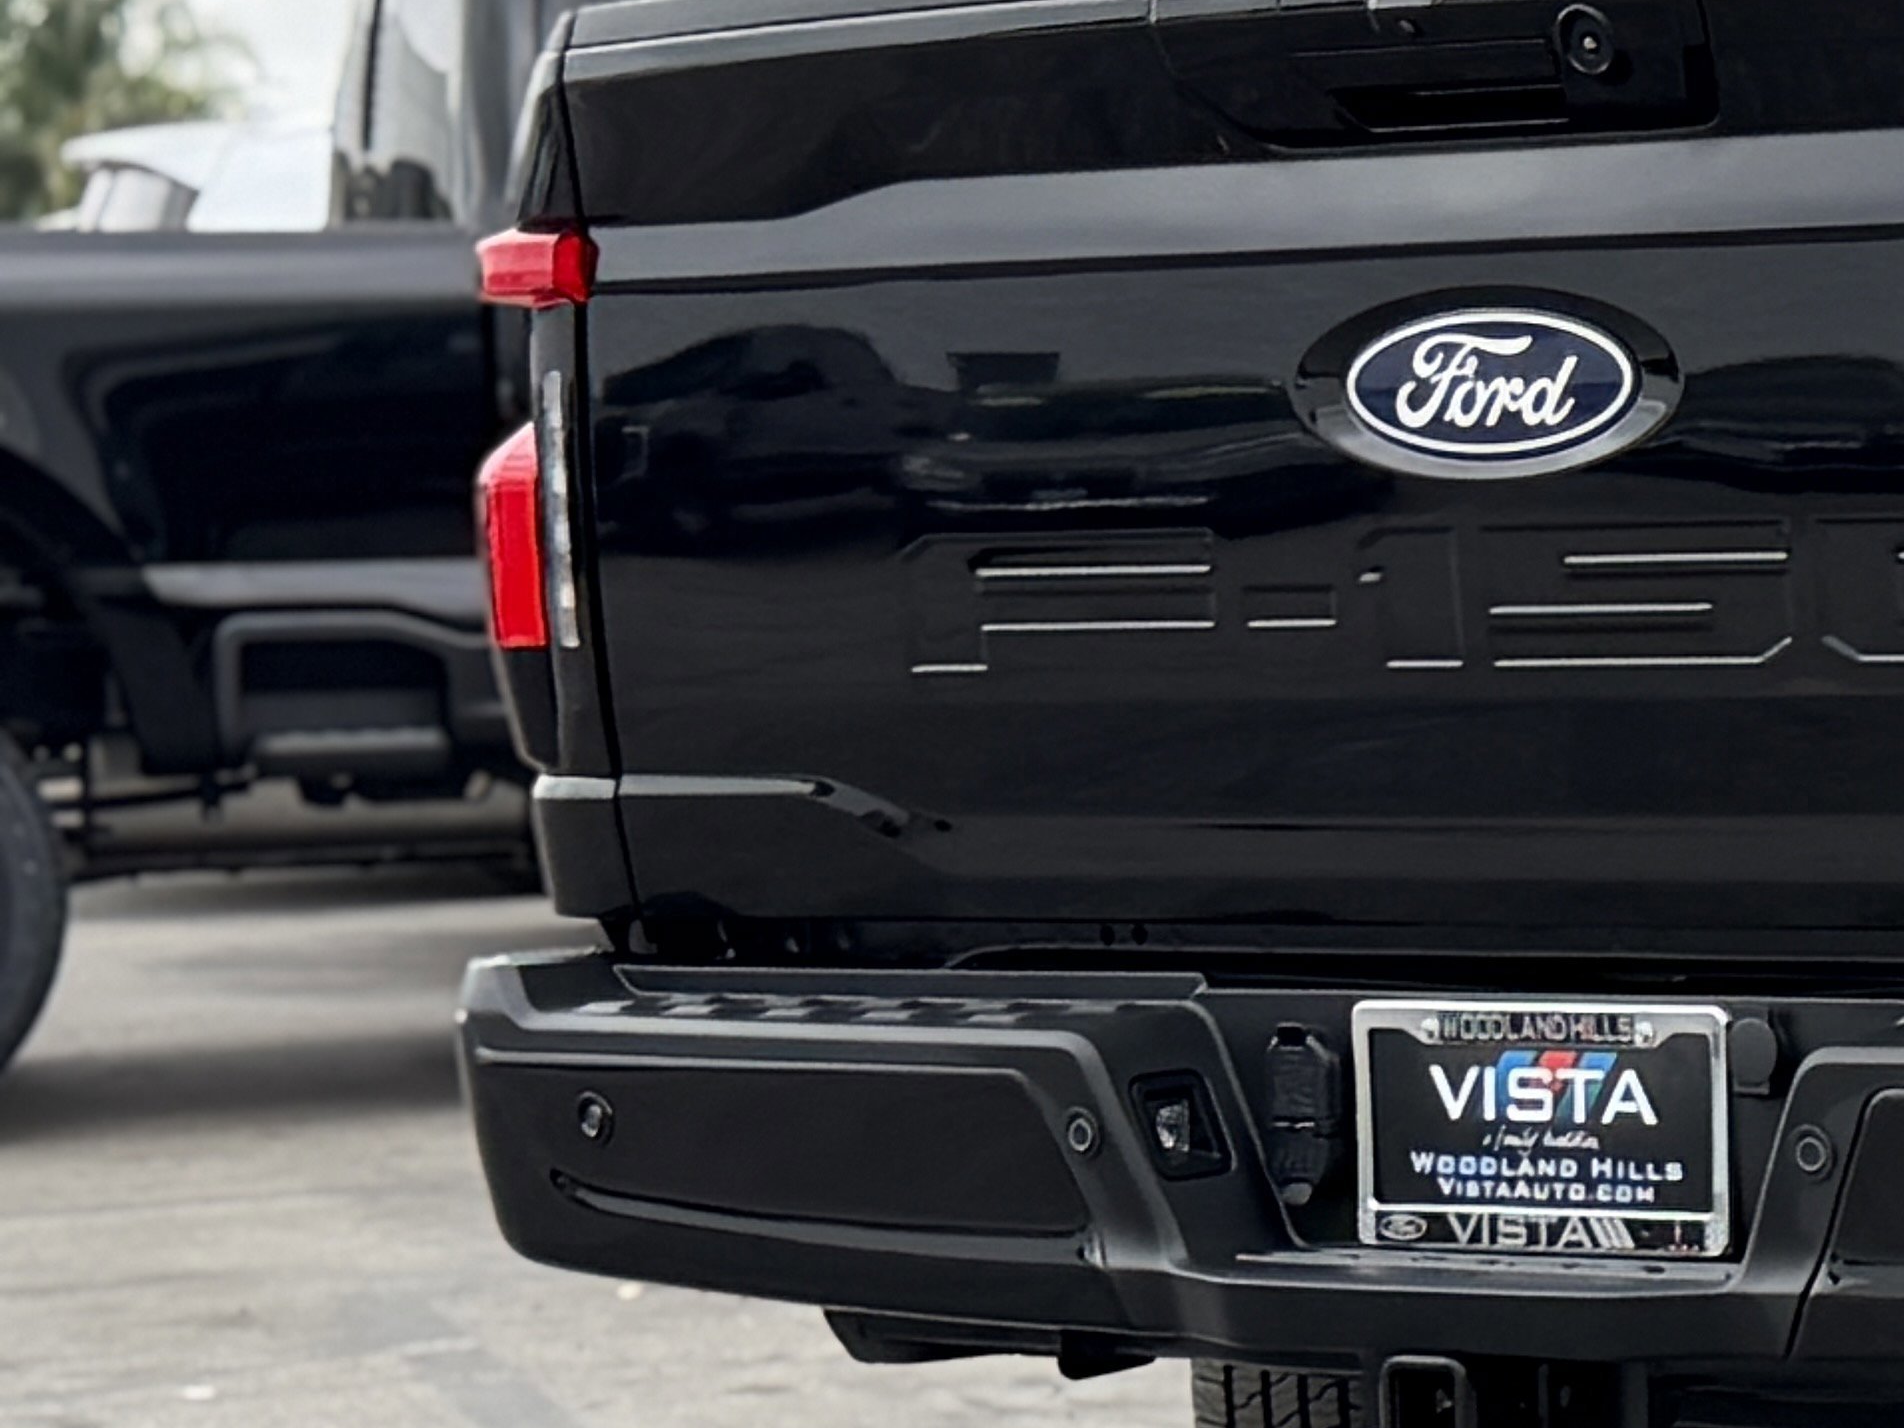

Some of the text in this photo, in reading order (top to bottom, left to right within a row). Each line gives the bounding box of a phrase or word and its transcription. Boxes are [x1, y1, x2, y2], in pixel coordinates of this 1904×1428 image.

[1396, 333, 1578, 428] Ford
[1428, 1064, 1659, 1126] VISTA
[1446, 1212, 1595, 1248] VISTA
